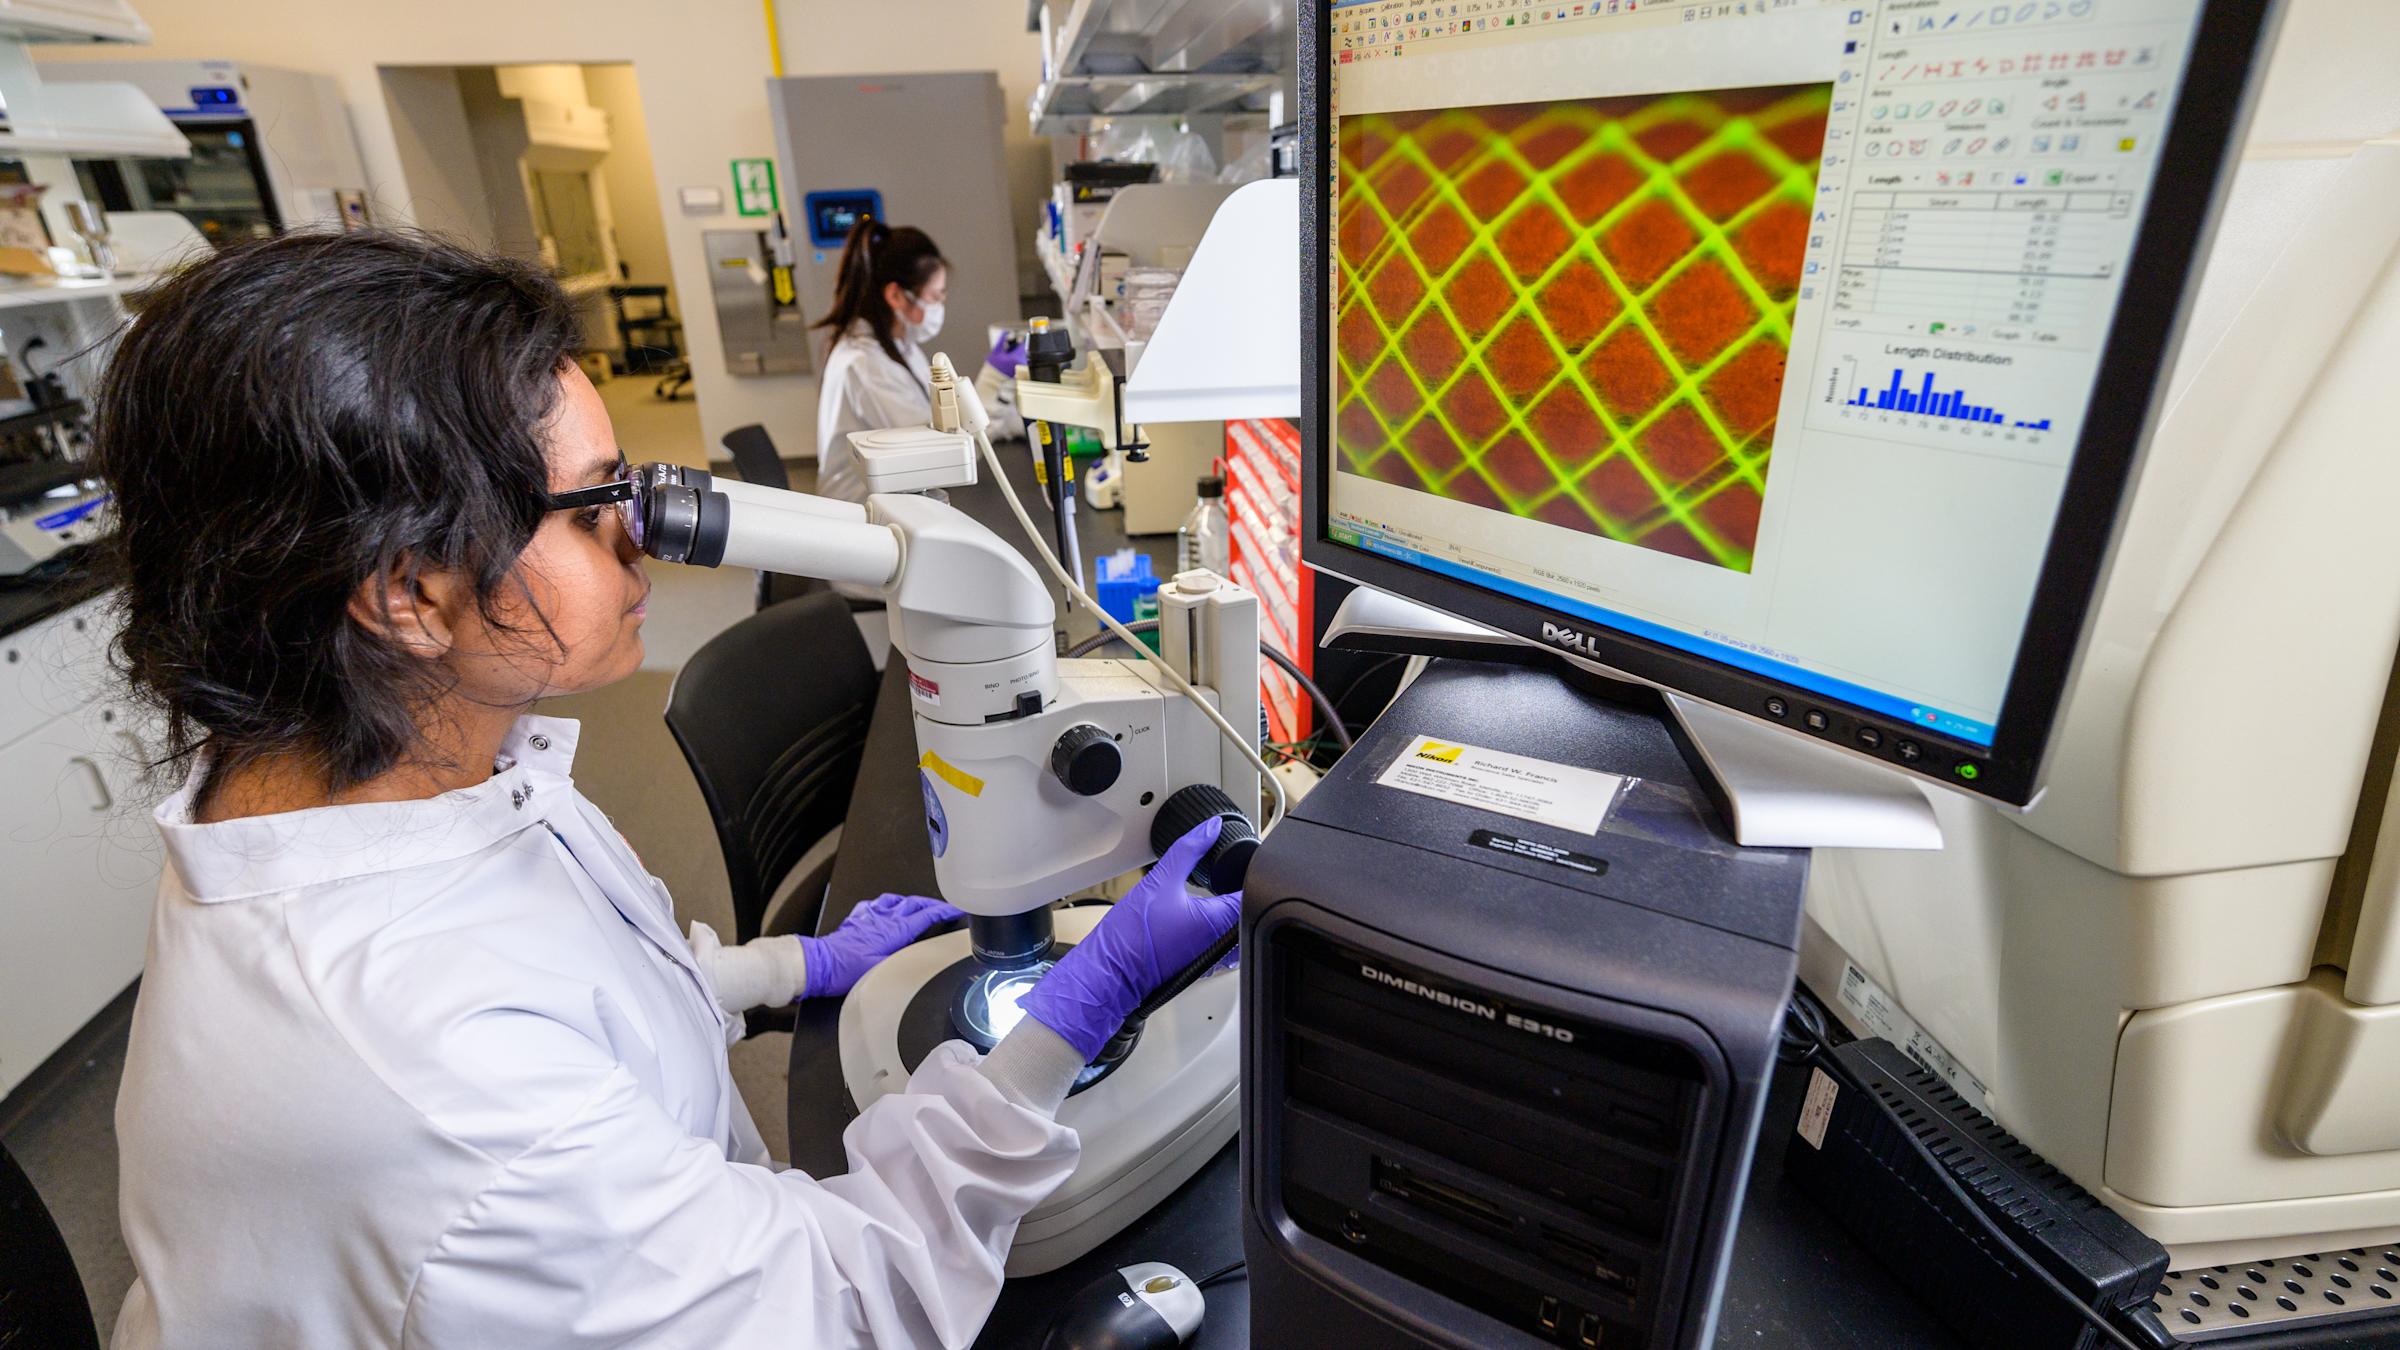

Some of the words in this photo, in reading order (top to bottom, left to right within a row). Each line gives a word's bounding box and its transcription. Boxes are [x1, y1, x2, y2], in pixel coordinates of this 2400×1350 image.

[1868, 174, 1903, 185] Length
[1884, 343, 1930, 360] Length
[1932, 347, 2013, 366] Distribution
[1543, 621, 1600, 657] DELL
[984, 682, 1000, 690] BINO
[1134, 726, 1150, 735] CLICK
[1415, 752, 1453, 765] Nikon
[1474, 760, 1509, 772] Richard
[1525, 771, 1558, 783] Francis
[1361, 964, 1496, 1020] DIMENSION
[1505, 1013, 1575, 1044] E310
